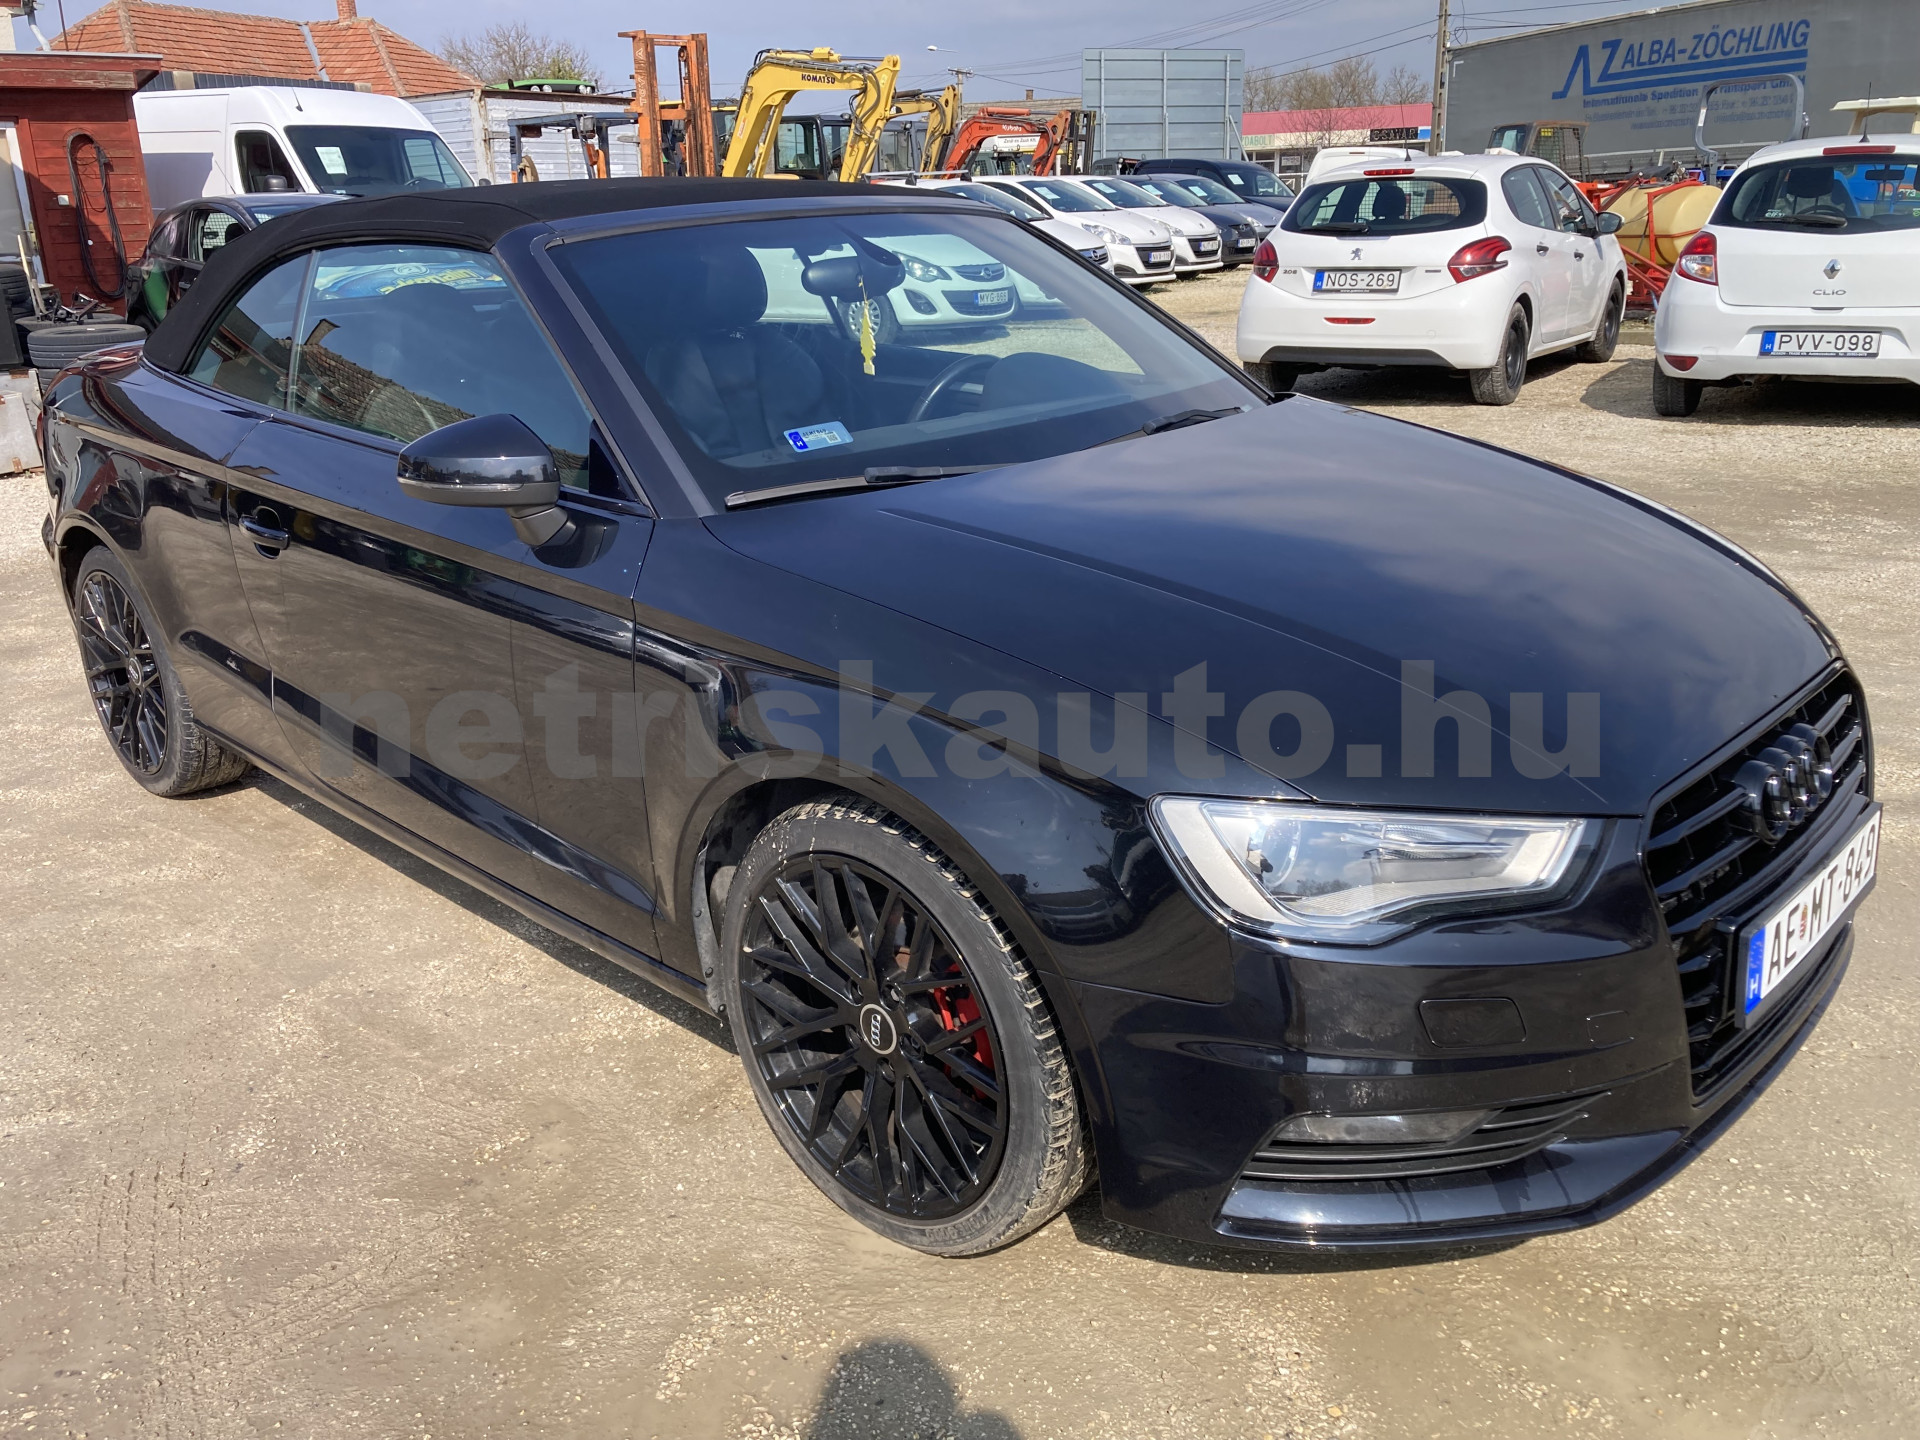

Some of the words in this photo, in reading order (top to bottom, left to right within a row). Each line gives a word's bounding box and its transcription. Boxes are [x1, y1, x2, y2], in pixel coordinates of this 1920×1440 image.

[1621, 18, 1811, 70] ALBA-ZÖCHLING
[801, 73, 836, 85] KOMATSU
[1651, 87, 1698, 102] Spedition
[1325, 273, 1396, 288] NOS-269
[1777, 334, 1874, 351] PVV-098
